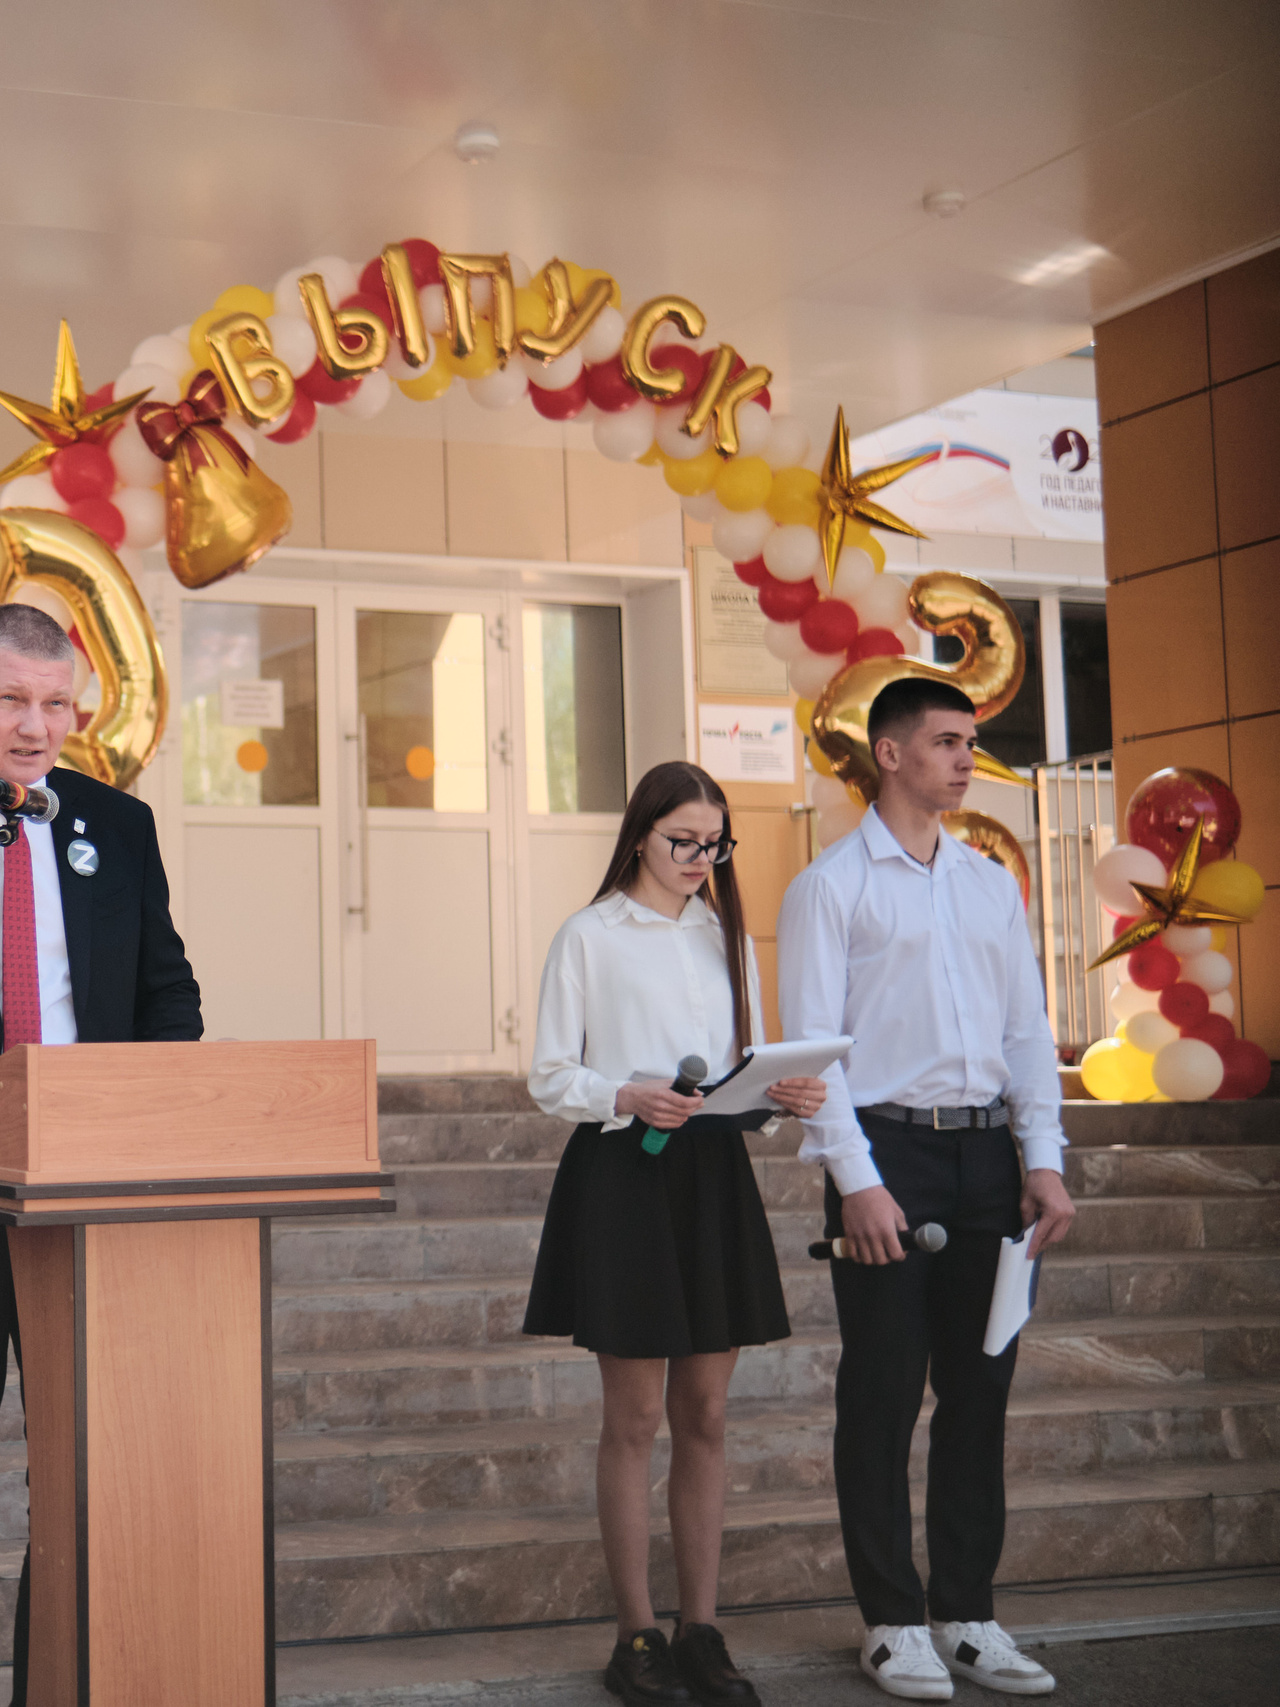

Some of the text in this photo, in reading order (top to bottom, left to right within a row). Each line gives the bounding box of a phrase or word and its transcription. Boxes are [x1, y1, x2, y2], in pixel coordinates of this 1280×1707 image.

[205, 242, 772, 457] ВЫПУСК
[1040, 473, 1061, 492] ГОД
[73, 843, 96, 872] Z
